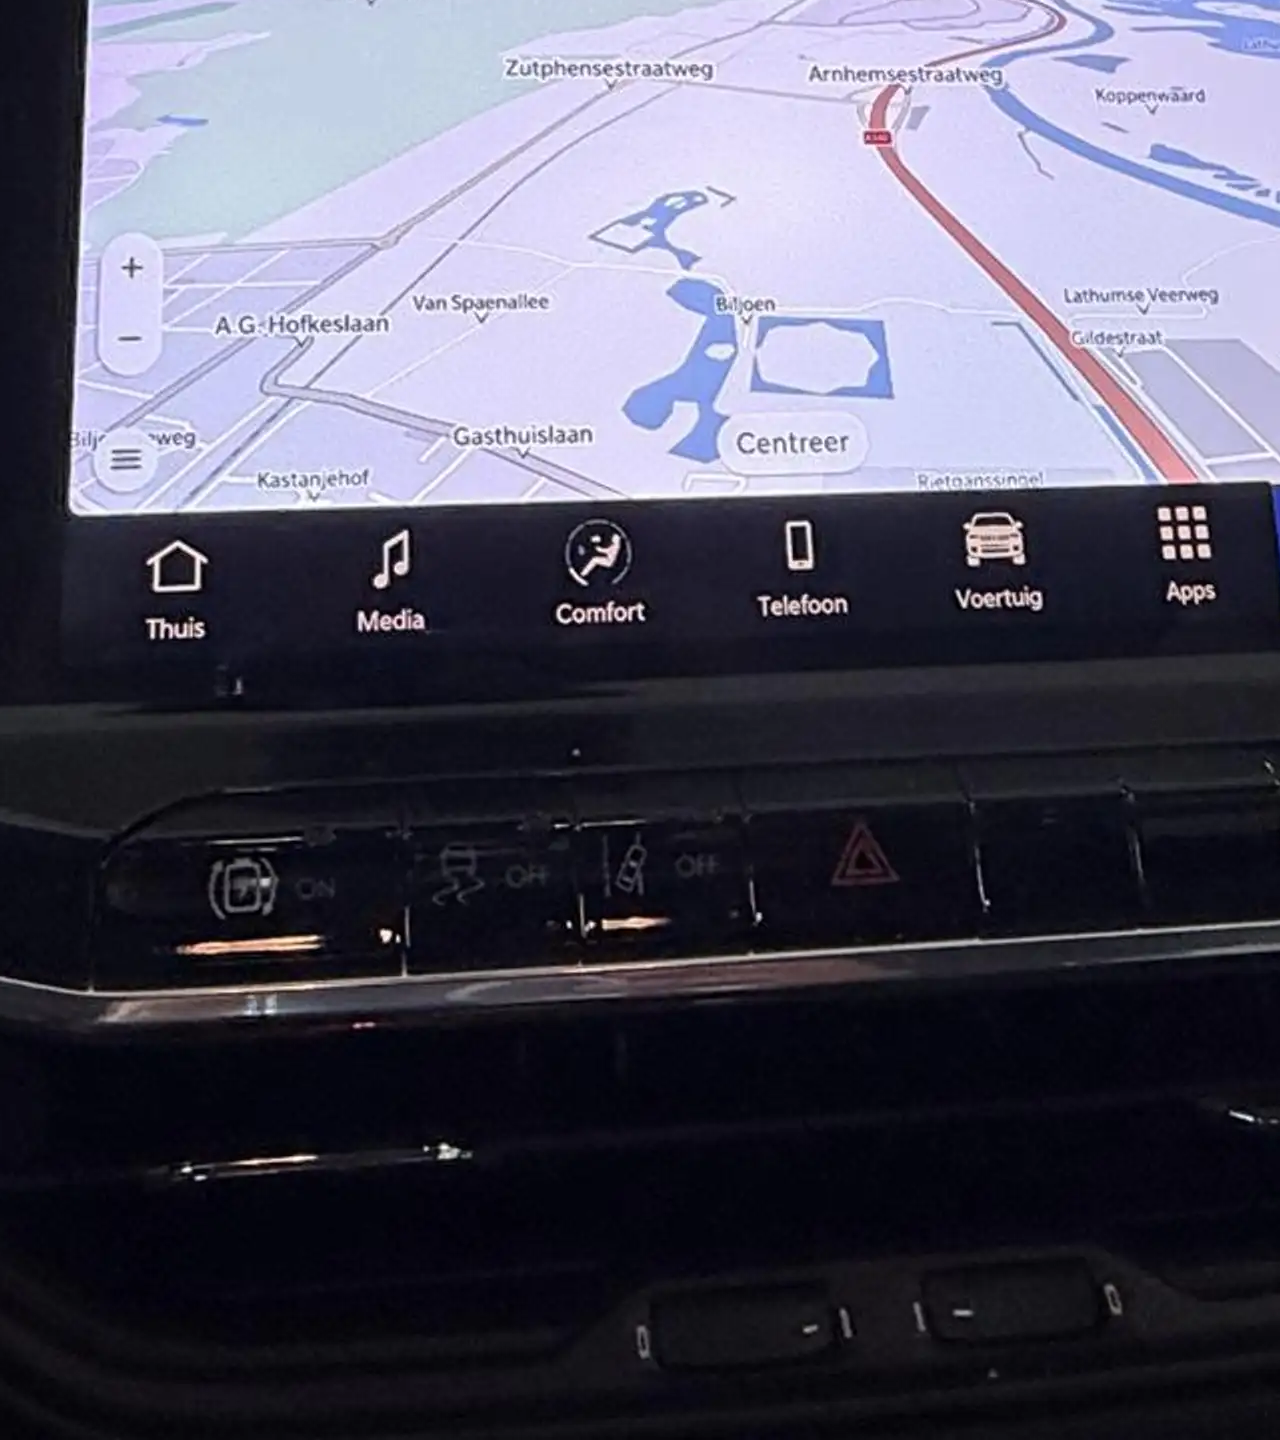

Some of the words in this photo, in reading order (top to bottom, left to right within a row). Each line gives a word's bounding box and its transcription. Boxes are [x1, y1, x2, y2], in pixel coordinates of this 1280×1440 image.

[504, 58, 714, 82] Zutphensestraatweg
[808, 65, 1004, 85] Arnhemsestraatweg
[1094, 88, 1206, 105] Koppenwaard
[412, 294, 448, 311] Van
[451, 293, 550, 315] Spaenallee
[1063, 287, 1144, 305] Lathumse
[1147, 288, 1220, 306] Veerweg
[269, 313, 390, 335] Hofkeslaan
[1071, 329, 1164, 346] Gildestraat
[453, 425, 593, 448] Gasthuislaan
[736, 431, 850, 455] Centreer
[256, 468, 370, 491] Kastanjehof
[954, 587, 1044, 615] Voertuig
[1165, 579, 1216, 606] Apps
[555, 602, 646, 625] Comfort
[757, 594, 849, 618] Telefoon
[145, 618, 205, 640] Thuis
[357, 608, 426, 633] Media
